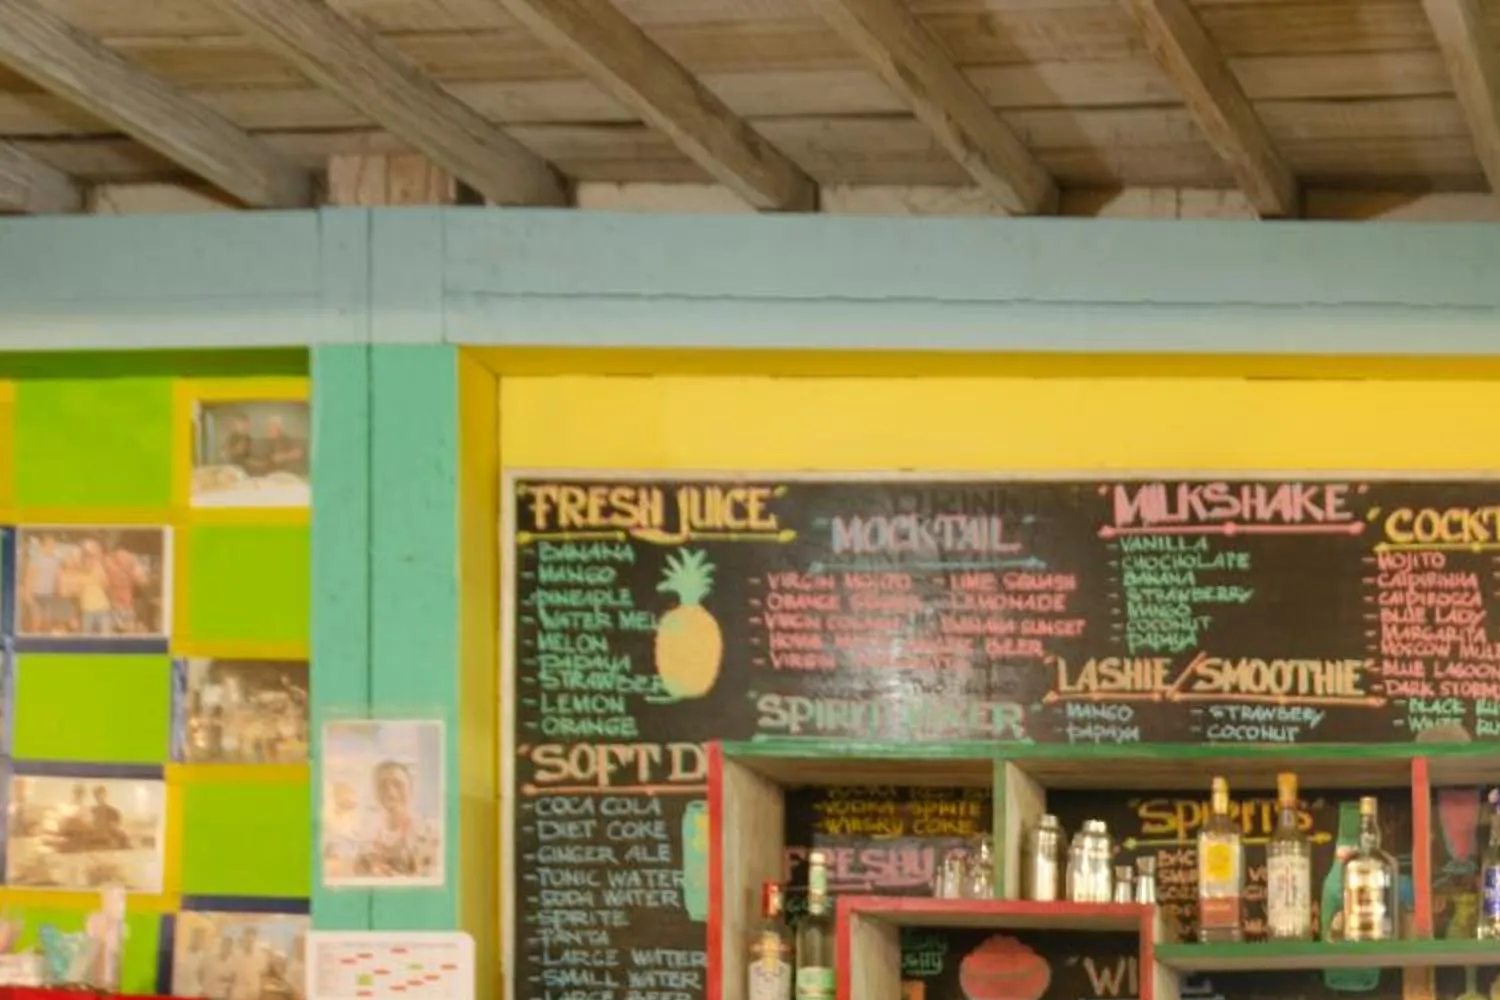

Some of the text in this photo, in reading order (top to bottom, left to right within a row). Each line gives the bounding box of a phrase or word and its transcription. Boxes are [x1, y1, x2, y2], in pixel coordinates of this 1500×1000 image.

[1120, 536, 1209, 551] VANILLA
[1378, 551, 1447, 572] MOJITO
[538, 565, 616, 584] MANGO
[1123, 570, 1197, 587] BANANA
[537, 606, 613, 630] WATER
[540, 692, 627, 714] LEMON
[541, 715, 639, 737] ORANGE
[1207, 724, 1300, 742] COCONUT
[535, 796, 662, 815] COCA COLA
[537, 819, 669, 841] DIET COKE
[624, 844, 672, 862] ALE
[537, 867, 601, 887] TONIC
[602, 889, 681, 908] WATER
[543, 968, 619, 987] SMALL
